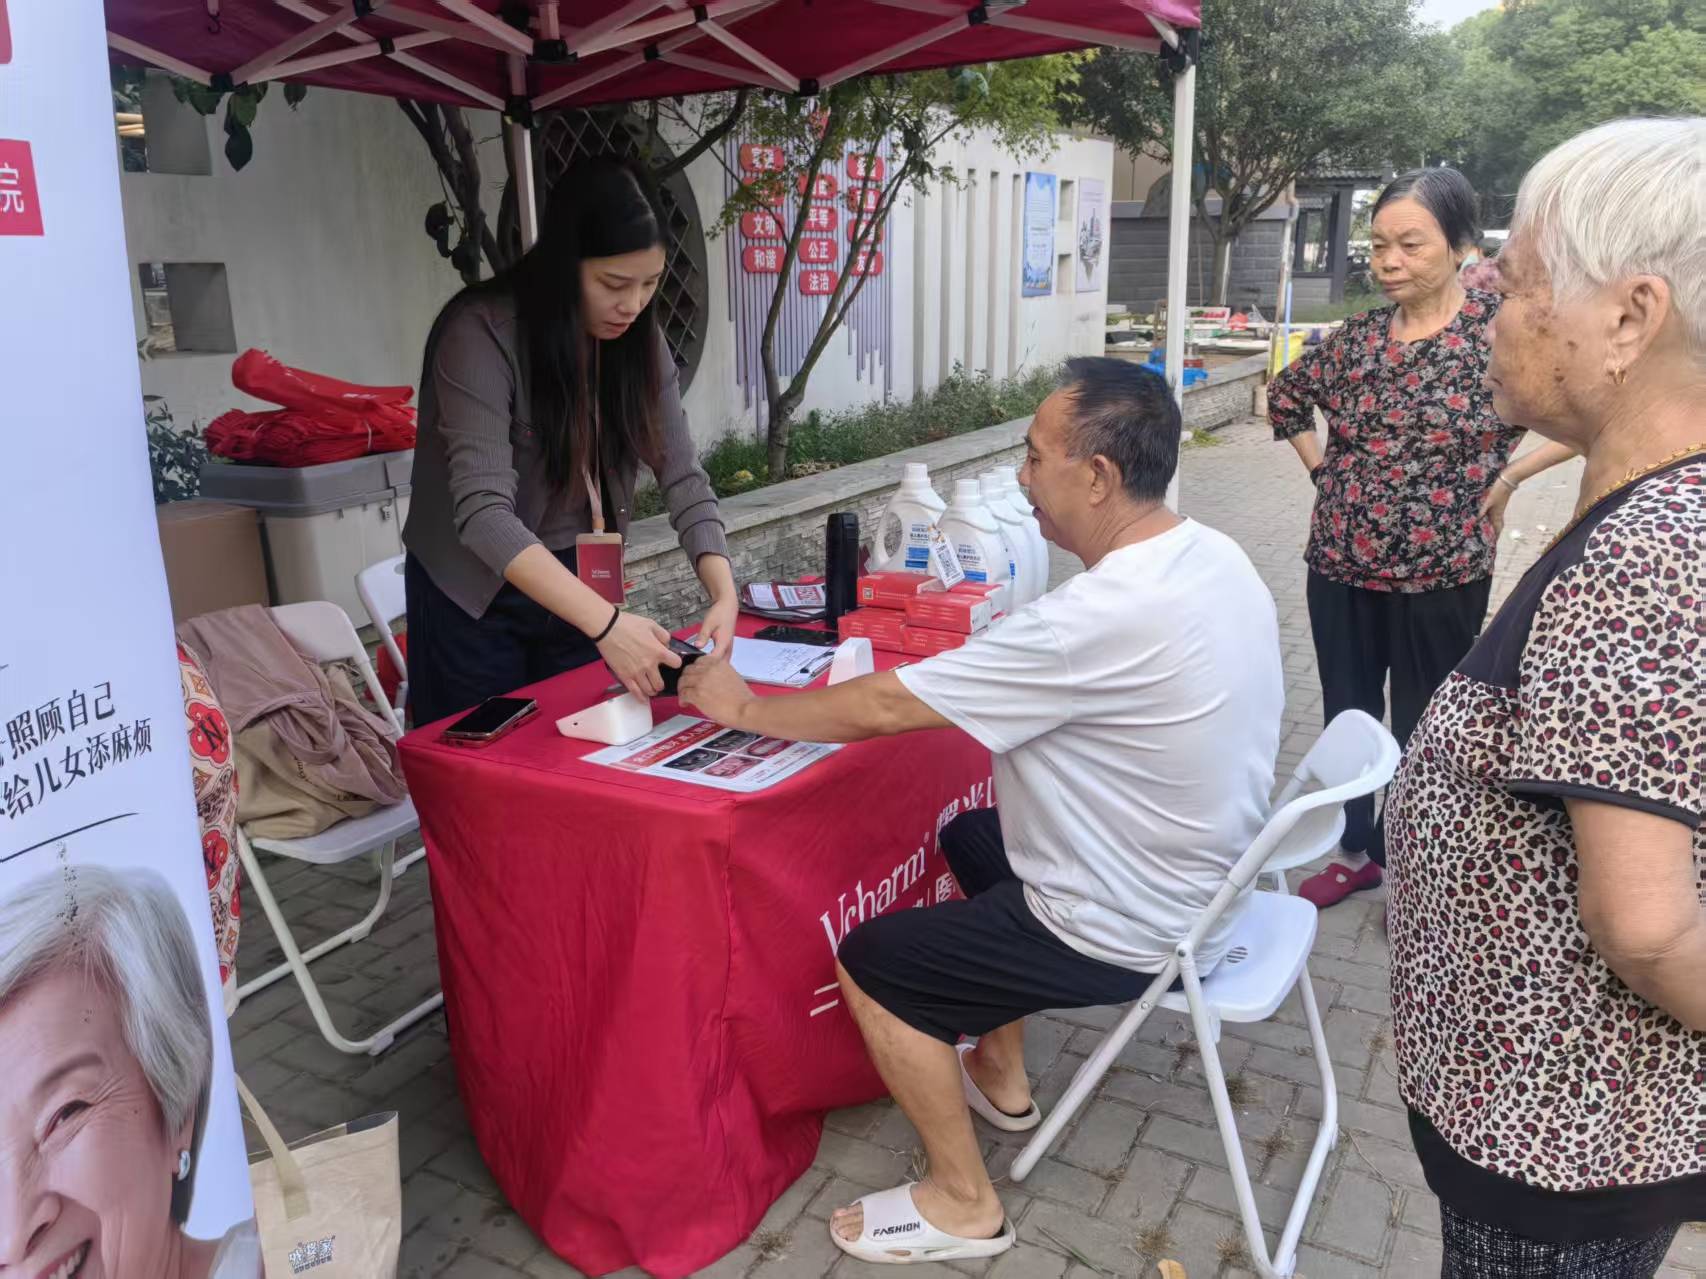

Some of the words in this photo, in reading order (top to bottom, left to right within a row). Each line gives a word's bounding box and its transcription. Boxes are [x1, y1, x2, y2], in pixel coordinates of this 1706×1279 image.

[753, 214, 777, 235] 文明
[808, 208, 829, 228] 平等
[754, 248, 777, 269] 和谐
[808, 241, 829, 259] 公正
[809, 272, 830, 291] 法治
[0, 681, 116, 766] 照顾自己
[0, 717, 152, 820] 给儿女添麻烦
[873, 1221, 921, 1237] FASHION
